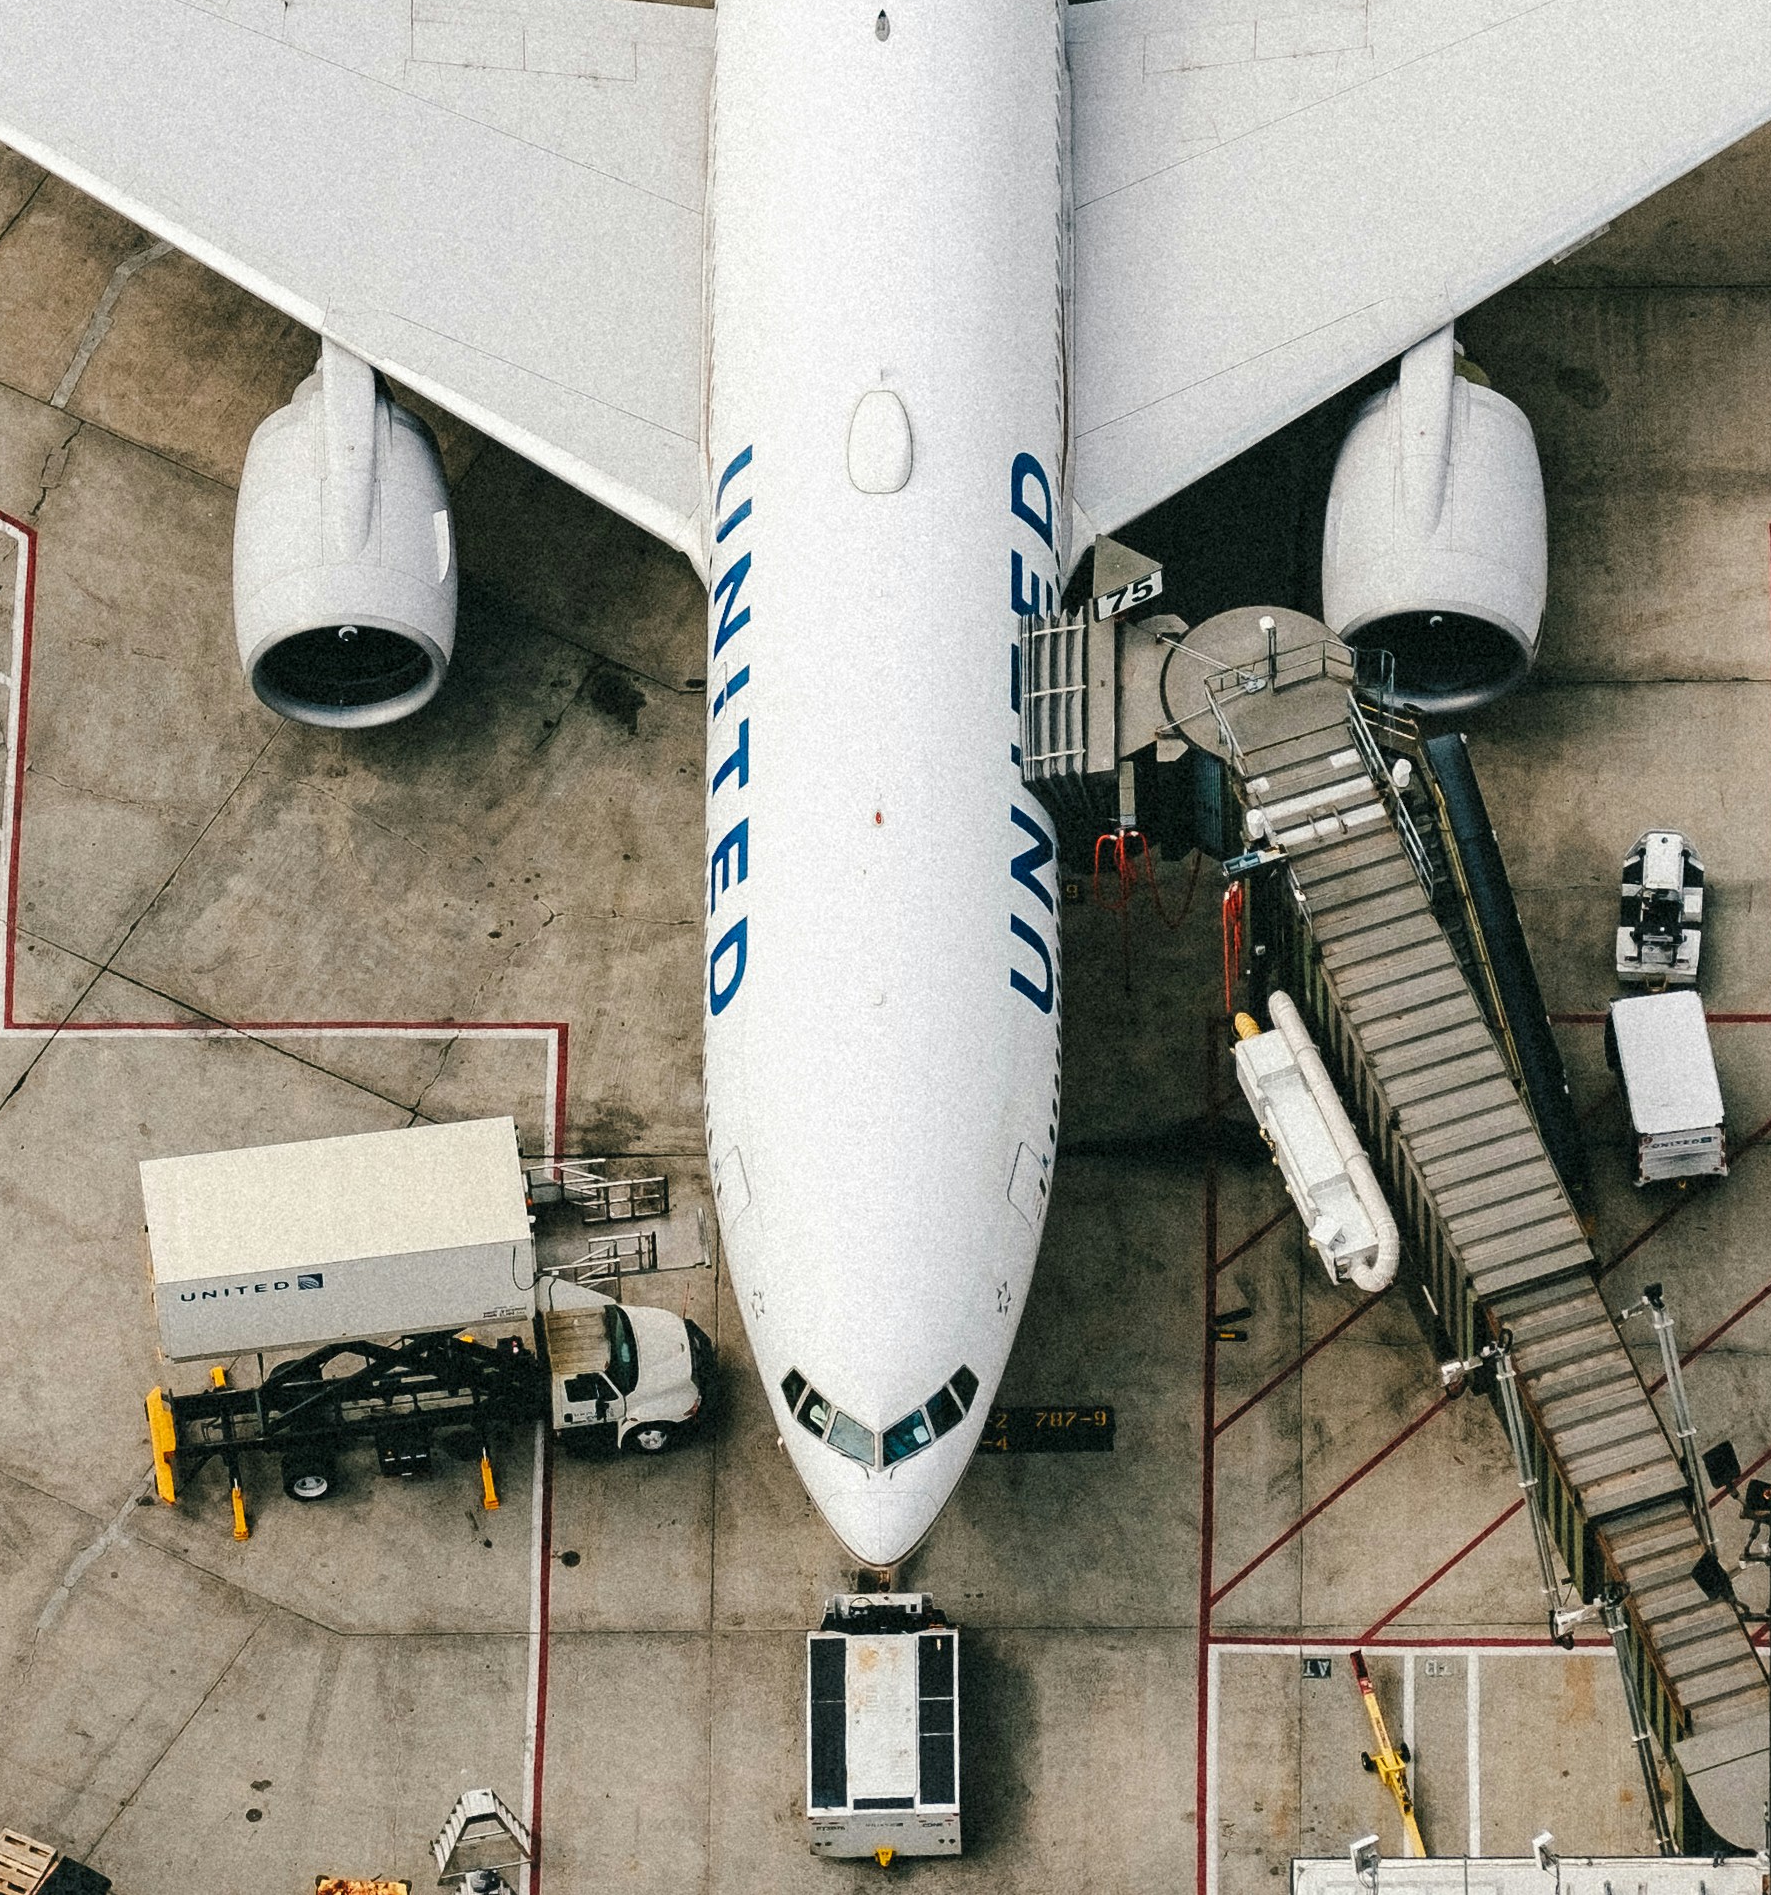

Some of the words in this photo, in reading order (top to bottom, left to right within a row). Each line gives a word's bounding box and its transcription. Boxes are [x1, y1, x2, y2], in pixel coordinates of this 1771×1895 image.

[1107, 576, 1153, 613] 75
[710, 444, 754, 1016] UNITED
[1010, 451, 1057, 1016] UNED
[181, 1281, 290, 1302] UNITED
[1035, 1411, 1107, 1427] 787-9
